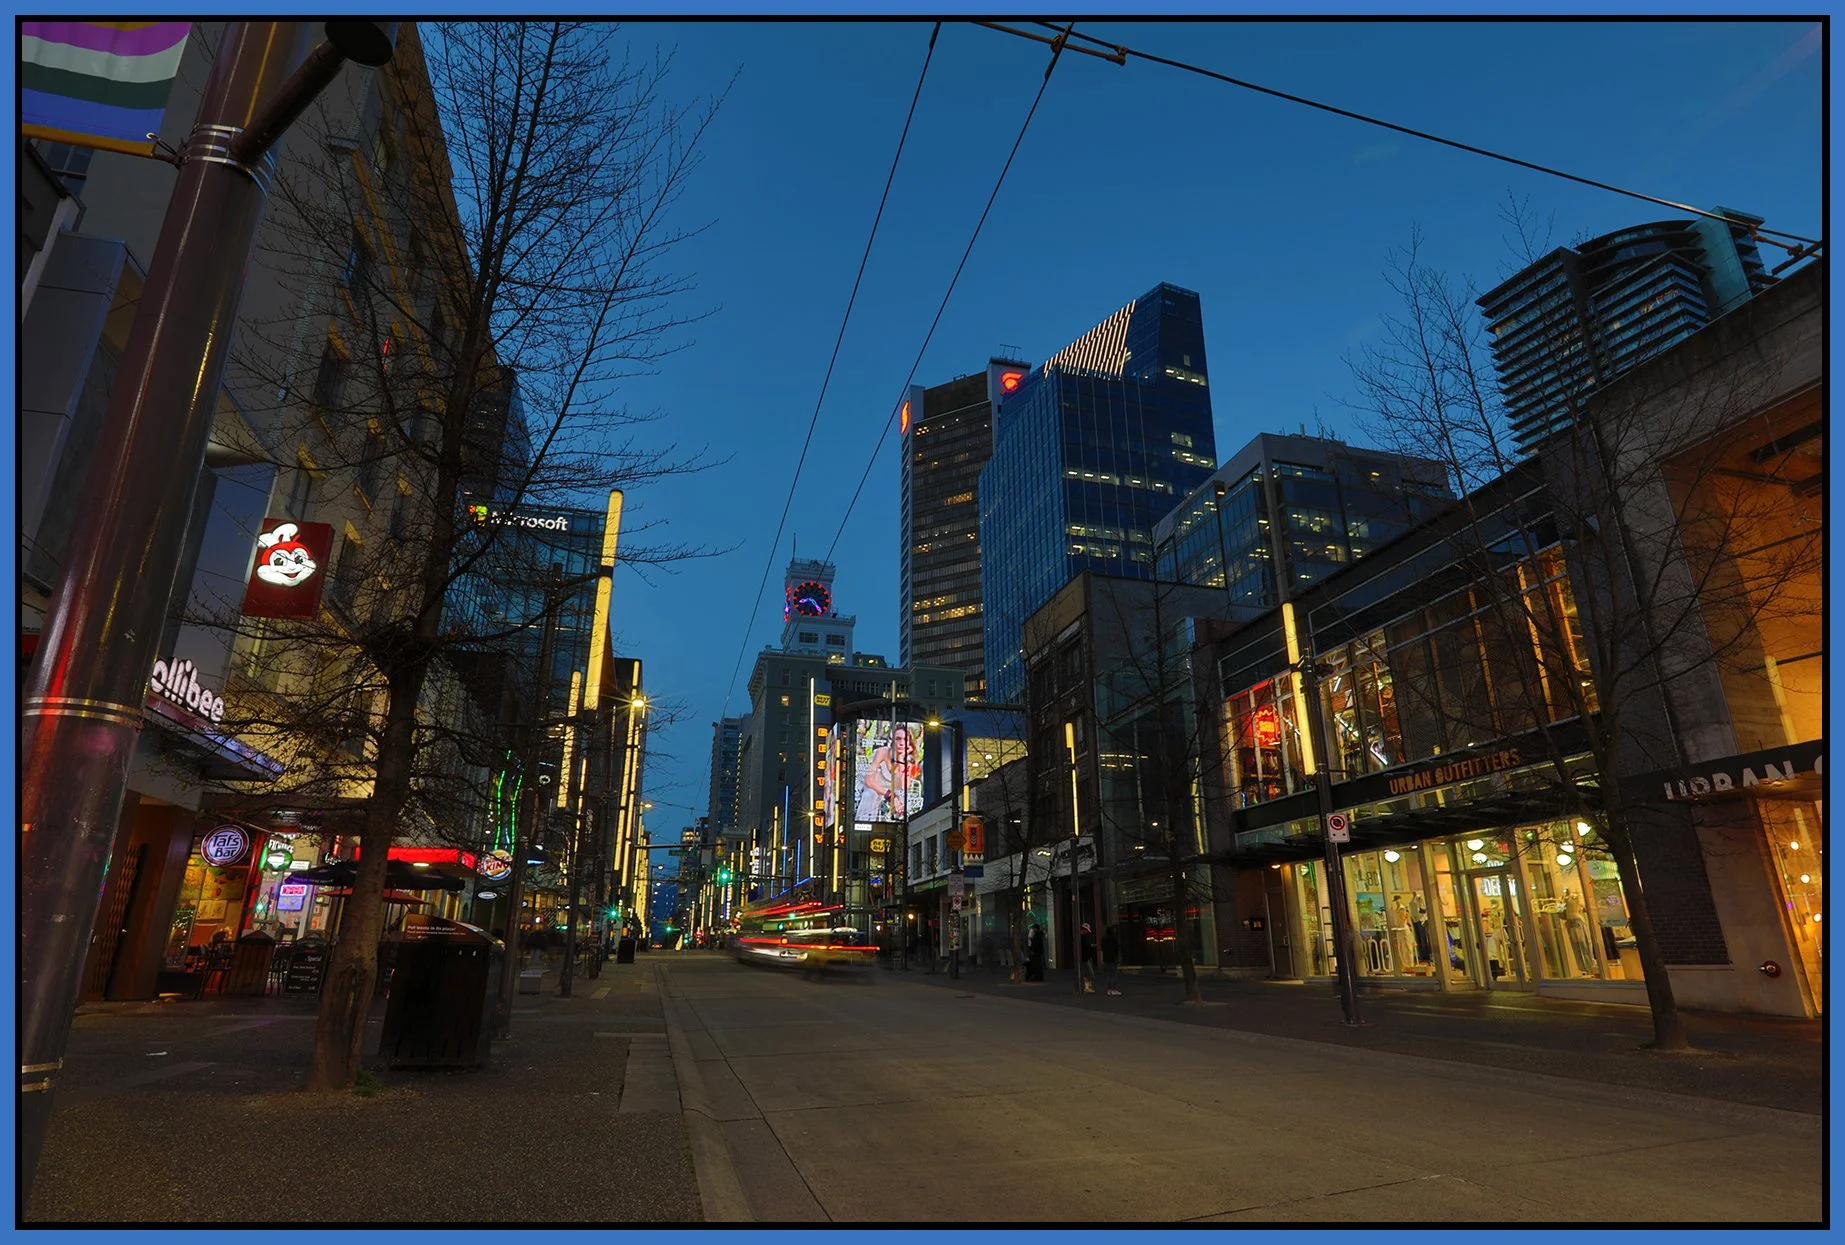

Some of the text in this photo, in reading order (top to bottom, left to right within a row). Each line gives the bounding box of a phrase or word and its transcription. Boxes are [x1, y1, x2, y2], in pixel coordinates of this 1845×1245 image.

[151, 657, 224, 725] ollibee
[816, 727, 829, 786] BEST
[1389, 748, 1521, 795] URBAN OUTFITTERS
[214, 847, 237, 858] Bar
